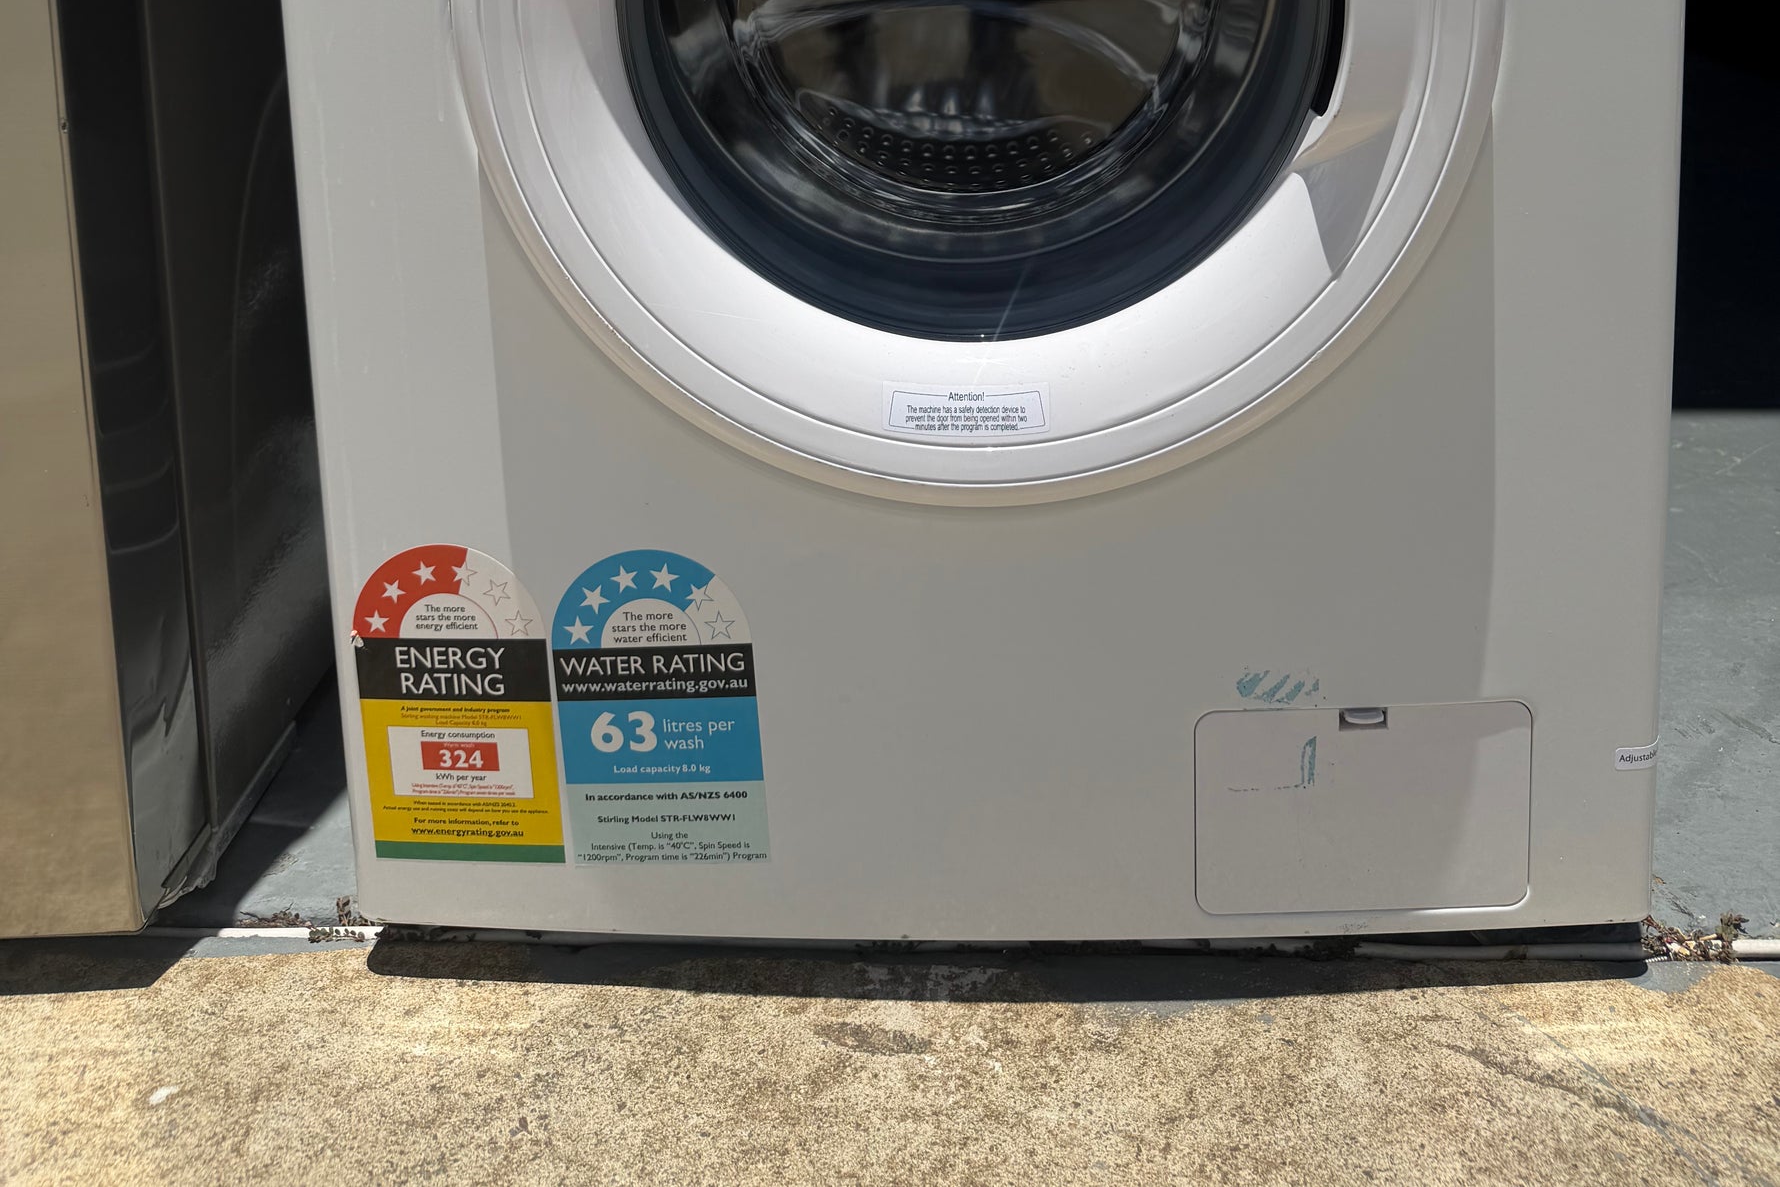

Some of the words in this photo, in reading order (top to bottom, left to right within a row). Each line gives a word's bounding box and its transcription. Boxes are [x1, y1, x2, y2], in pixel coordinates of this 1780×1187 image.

[948, 392, 985, 402] Attention!
[907, 405, 917, 413] The
[919, 405, 941, 413] machine
[942, 405, 952, 413] has
[959, 405, 974, 414] safety
[976, 405, 1000, 413] detection
[1002, 405, 1019, 413] device
[906, 415, 925, 423] prevent
[964, 415, 978, 423] being
[980, 415, 1000, 423] opened
[961, 424, 983, 432] program
[989, 423, 1019, 432] completed.
[623, 612, 643, 621] The
[646, 612, 673, 620] more
[416, 623, 443, 631] energy
[446, 622, 478, 630] efficient
[612, 624, 636, 632] stars
[640, 623, 656, 631] the
[660, 623, 686, 631] more
[613, 635, 643, 643] water
[647, 633, 687, 642] efficient
[395, 646, 505, 670] ENERGY
[560, 656, 645, 676] WATER
[653, 652, 745, 673] RATING
[400, 673, 505, 695] RATING
[562, 677, 748, 693] www.waterrating.gov.au
[590, 710, 658, 753] 63
[663, 719, 702, 733] litres
[709, 720, 735, 735] per
[421, 730, 445, 740] Energy
[448, 731, 495, 740] consumption
[664, 735, 704, 750] wash
[439, 750, 483, 768] 324
[614, 765, 637, 773] Load
[640, 765, 680, 774] capacity
[682, 764, 696, 772] 8.0
[699, 764, 711, 773] kg
[436, 773, 455, 781] kWh
[597, 793, 653, 801] accordance
[656, 792, 678, 800] with
[680, 791, 720, 800] AS/NZS
[724, 791, 748, 799] 6400
[448, 818, 492, 827] information,
[597, 816, 629, 825] Stirling
[632, 815, 658, 823] Model
[660, 814, 736, 822] STR-FLW8WW1
[411, 827, 524, 838] www.energyrating.gov.au
[651, 831, 673, 840] Using
[675, 831, 688, 839] the
[591, 843, 626, 851] Intensive
[628, 842, 656, 851] (Temp.
[699, 842, 715, 850] Spin
[718, 841, 741, 850] Speed
[625, 853, 659, 862] Program
[733, 851, 767, 860] Program
